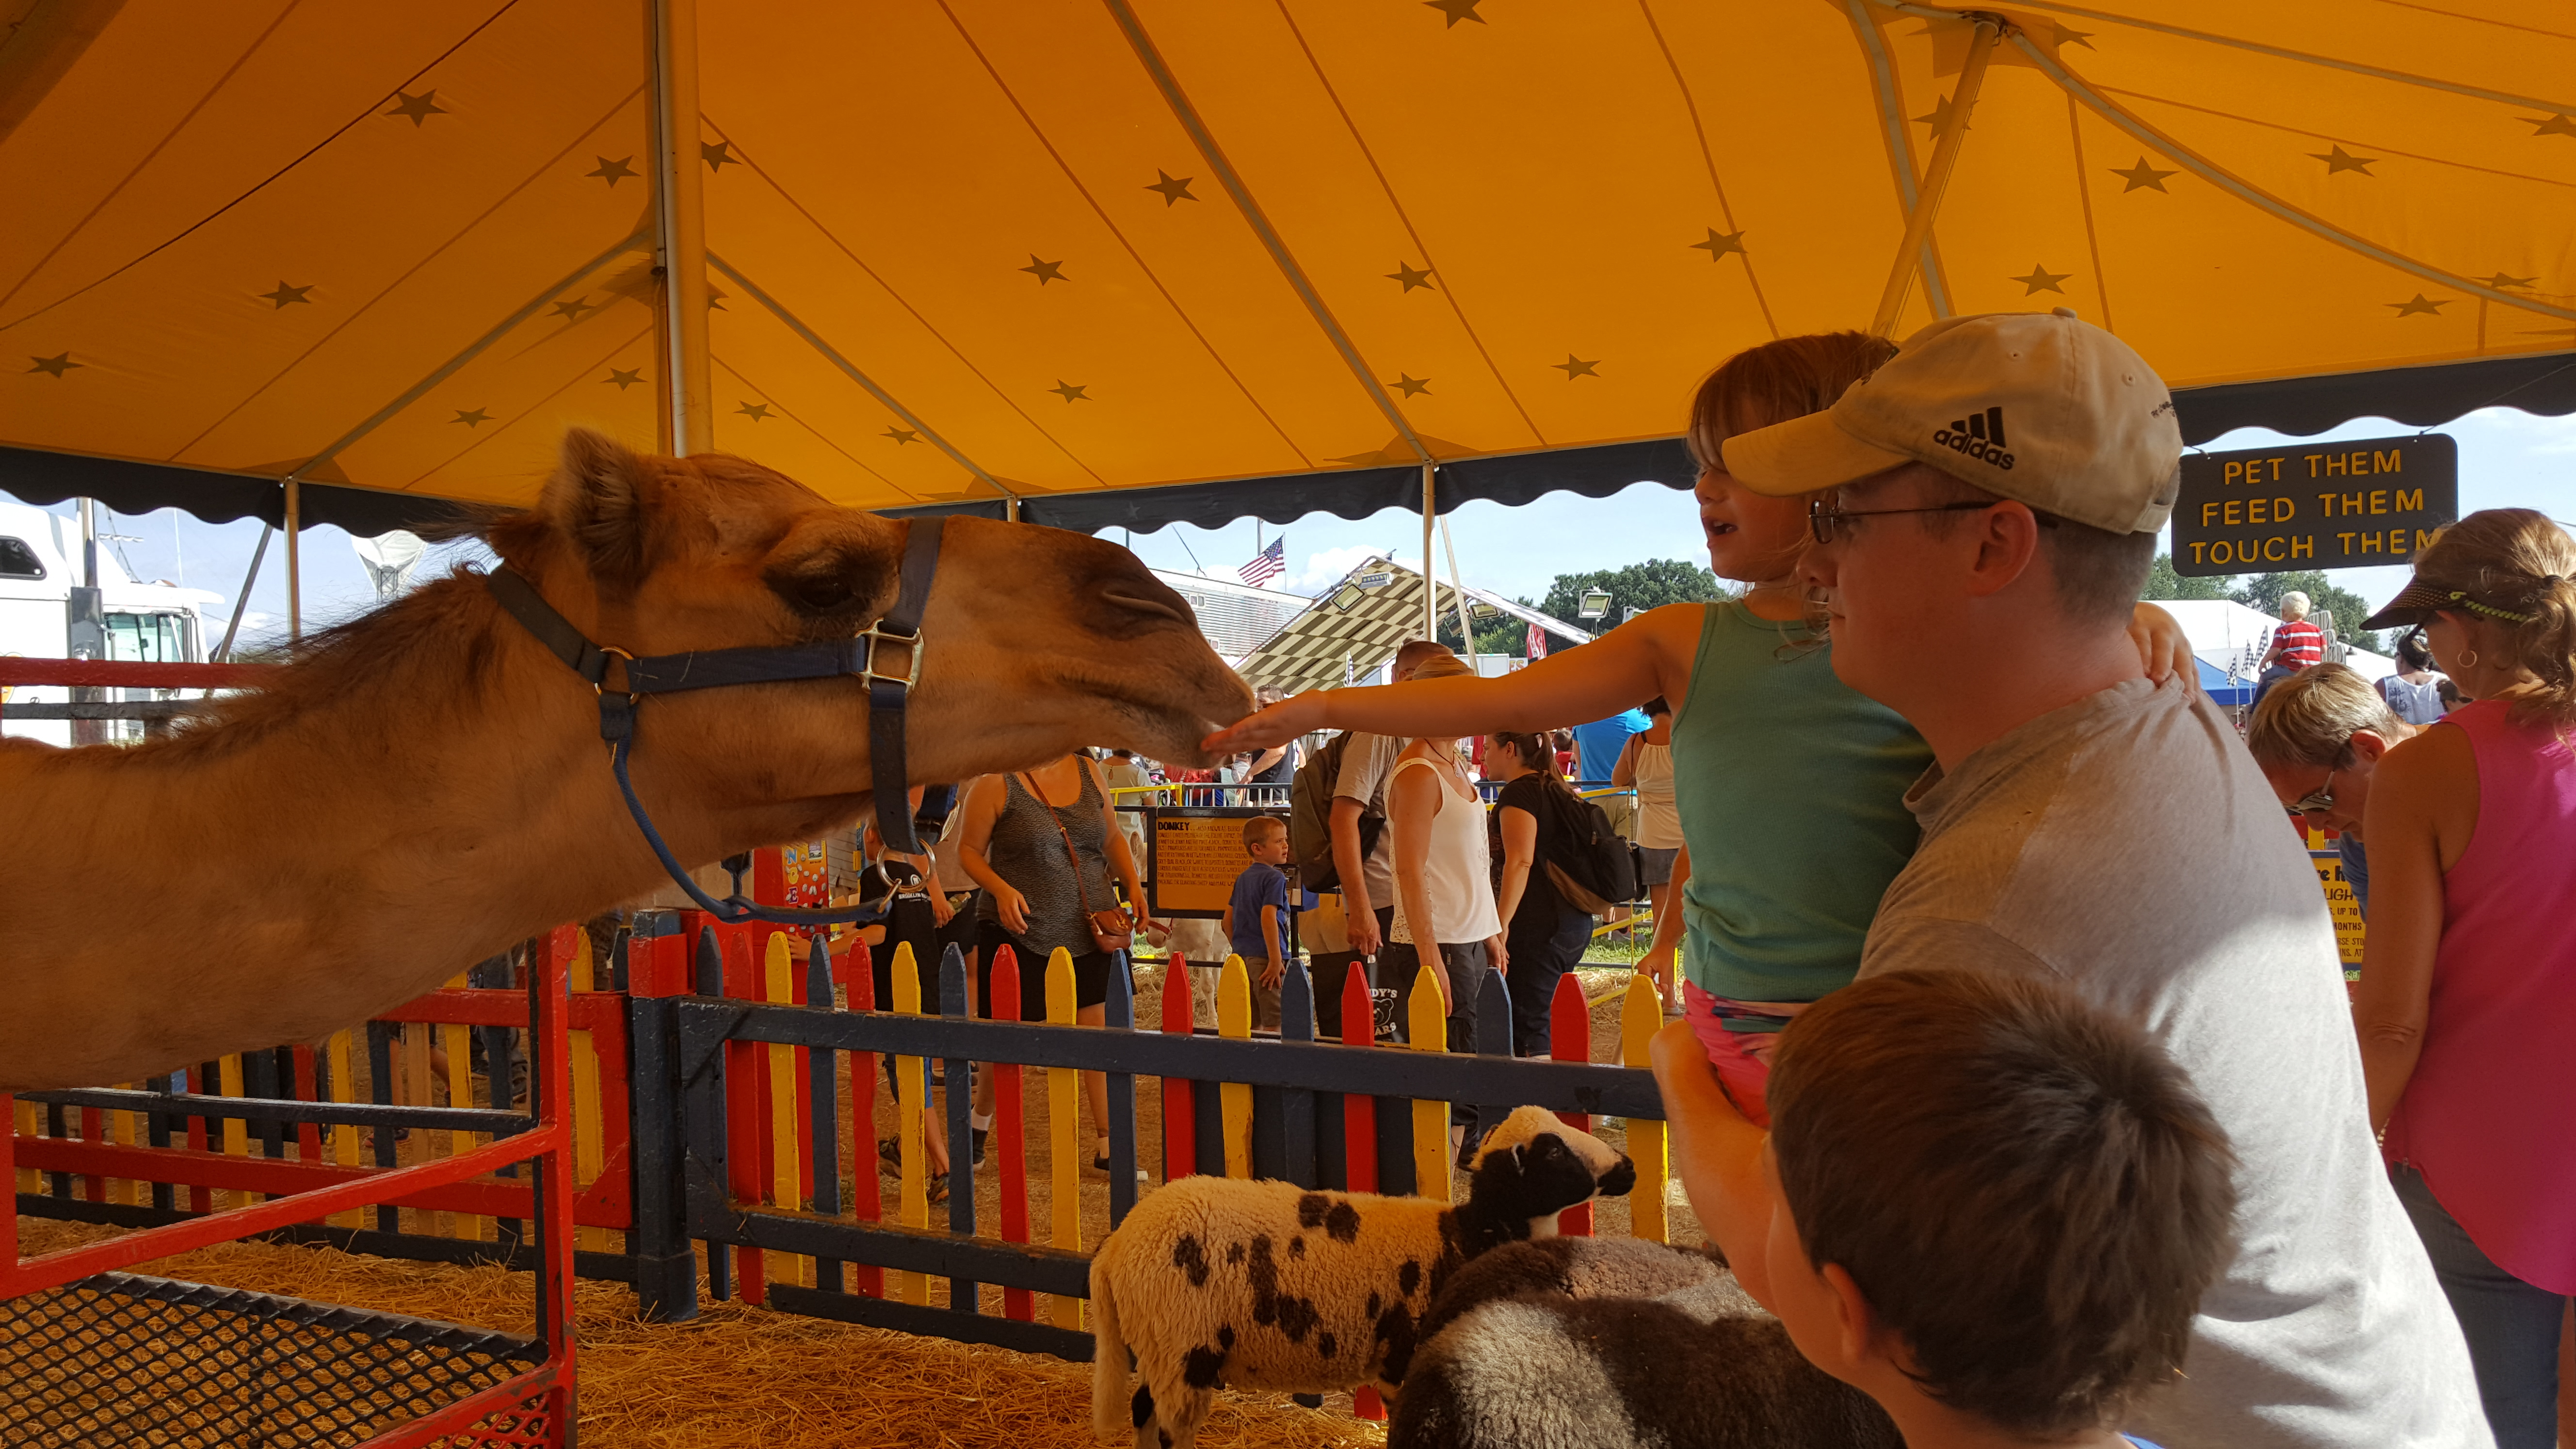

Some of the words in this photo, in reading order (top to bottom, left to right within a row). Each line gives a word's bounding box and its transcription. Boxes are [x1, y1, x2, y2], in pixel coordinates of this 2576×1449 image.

[1933, 429, 2015, 470] adidas
[2224, 457, 2286, 484] PET
[2304, 449, 2402, 478] THEM
[2202, 497, 2296, 527] FEED
[2318, 488, 2424, 517] THEM
[2189, 534, 2314, 564] TOUCH
[1509, 660, 1525, 673] ES
[1158, 821, 1190, 831] DONKEY
[2317, 869, 2330, 881] e
[2334, 865, 2346, 882] h
[2323, 888, 2353, 901] UGH
[2349, 907, 2358, 916] TO
[2351, 937, 2365, 946] STO
[1369, 988, 1398, 998] DY'S
